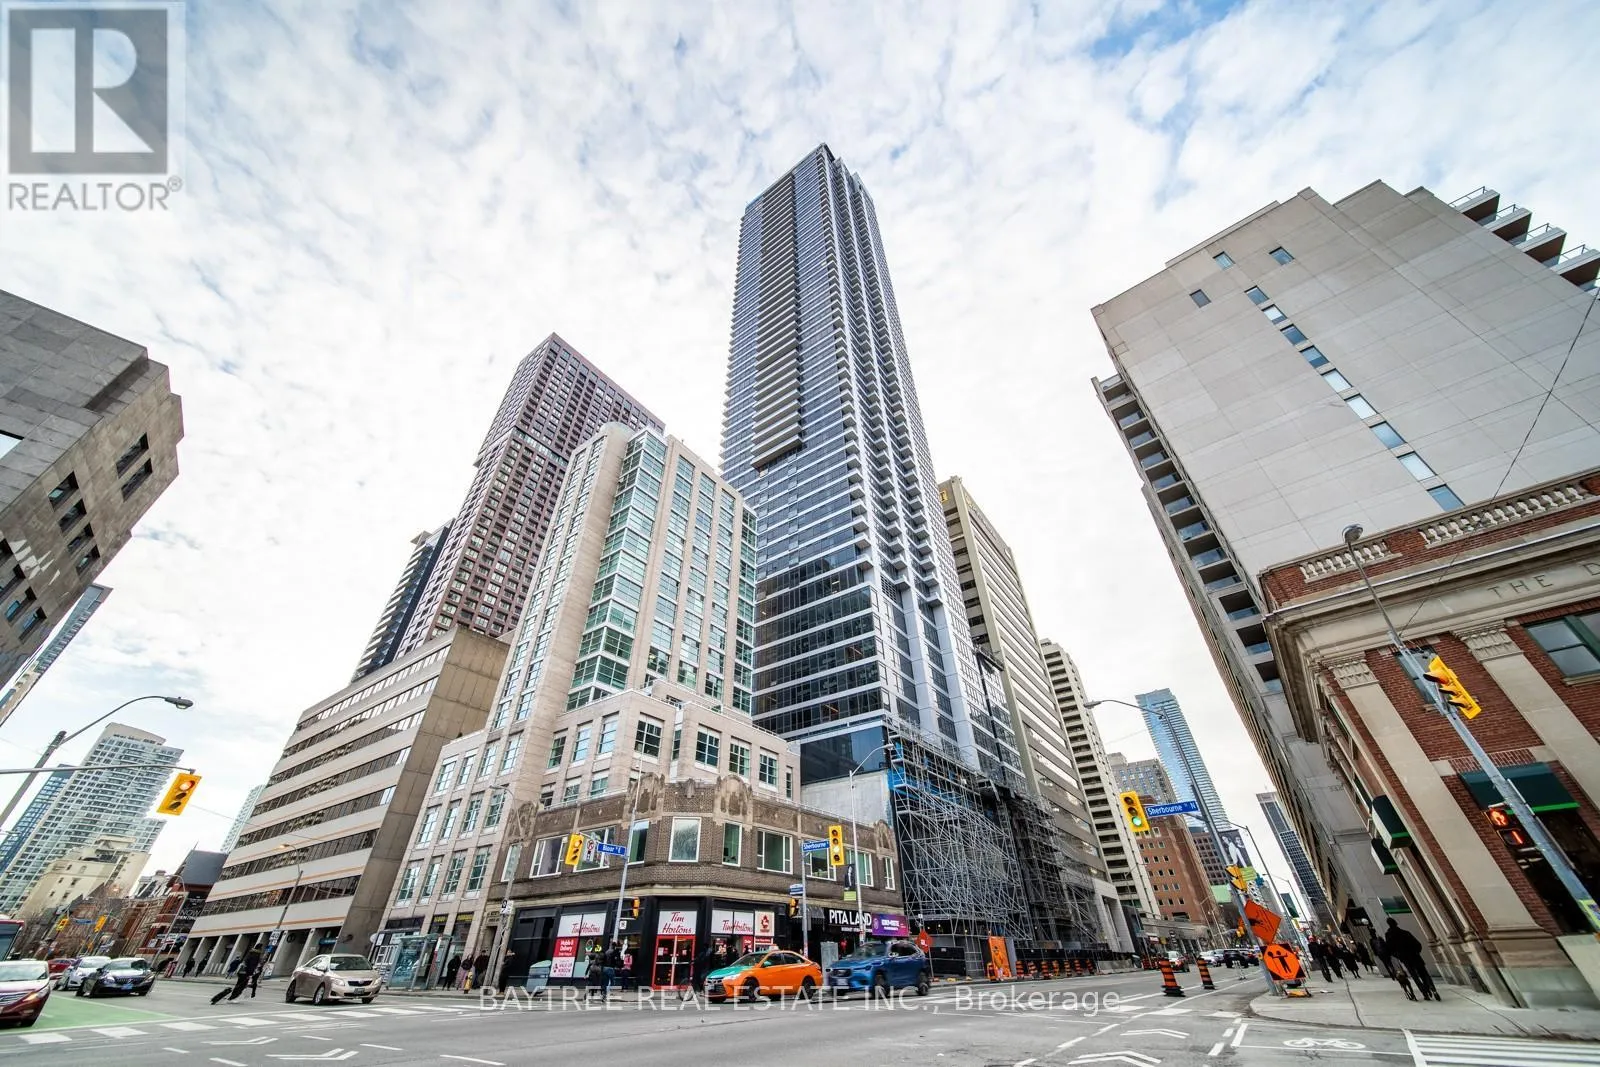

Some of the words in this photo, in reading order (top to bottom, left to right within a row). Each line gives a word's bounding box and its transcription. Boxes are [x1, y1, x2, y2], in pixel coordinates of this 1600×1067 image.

[1487, 574, 1553, 600] THE
[1147, 805, 1183, 815] Sherbourne
[1190, 802, 1196, 810] N
[671, 911, 685, 922] Tim
[828, 909, 849, 925] PITA
[849, 911, 873, 926] LAND
[581, 922, 601, 933] Hortons
[662, 922, 692, 934] Hortons
